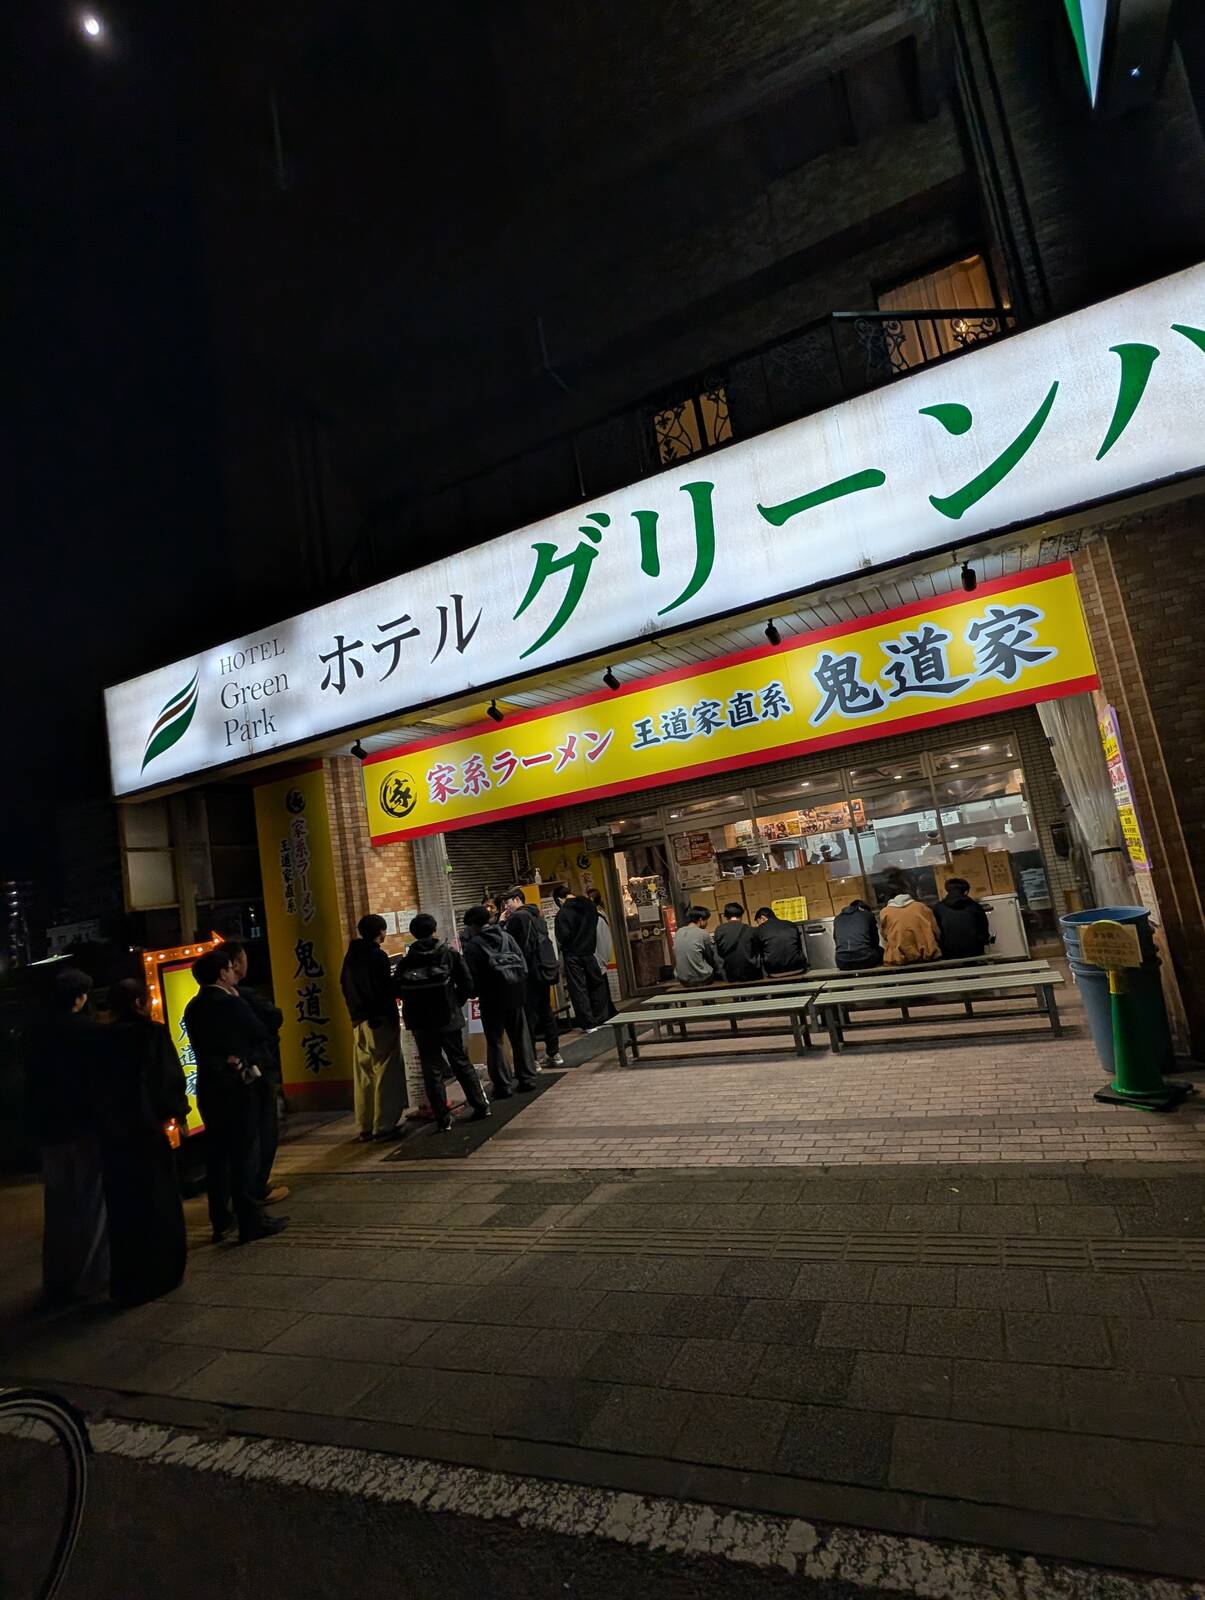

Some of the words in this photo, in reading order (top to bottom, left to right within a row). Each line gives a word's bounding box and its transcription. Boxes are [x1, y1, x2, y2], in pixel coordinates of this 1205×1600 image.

[220, 638, 285, 676] HOTEL
[319, 594, 482, 695] ホテル
[221, 672, 290, 709] Green
[427, 730, 613, 803] 家系ラーメン
[632, 682, 791, 749] 王道家直系
[813, 608, 1053, 722] 鬼道家
[224, 708, 278, 747] Park
[294, 938, 333, 1074] 鬼道家
